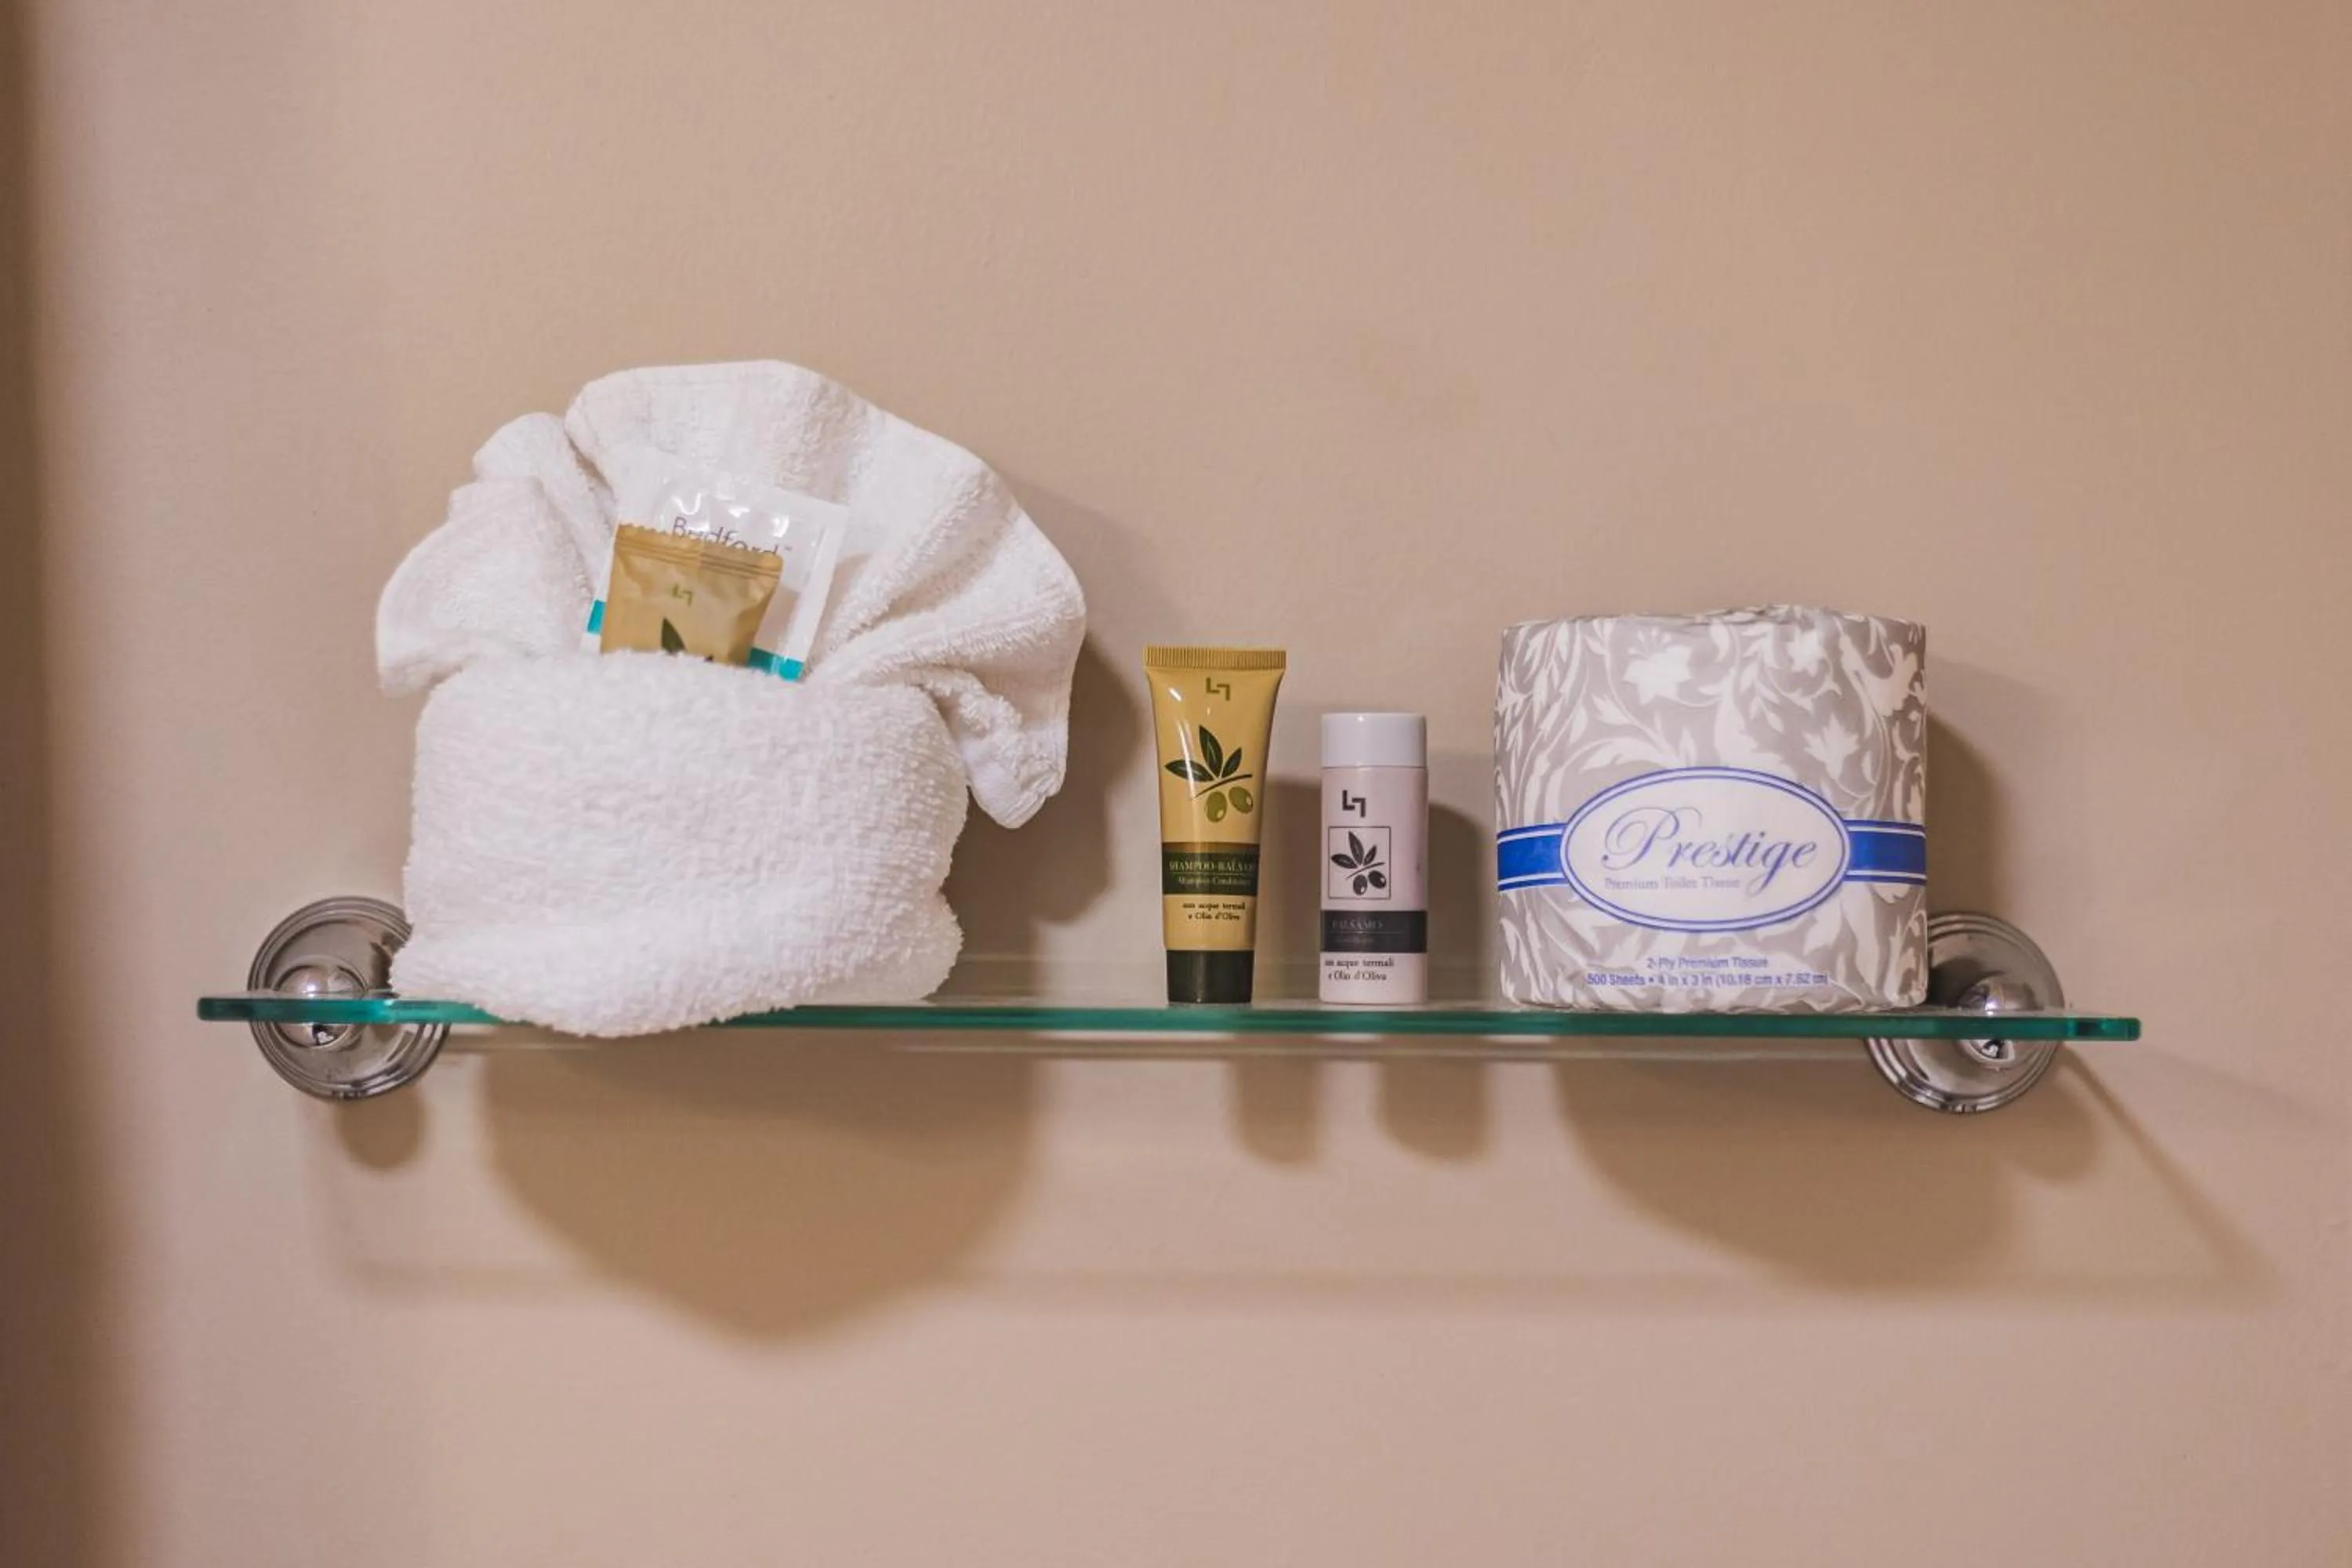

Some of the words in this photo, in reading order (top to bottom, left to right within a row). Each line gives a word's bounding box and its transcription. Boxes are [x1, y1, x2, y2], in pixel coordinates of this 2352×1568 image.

[672, 516, 779, 555] Bdfo
[1602, 807, 1817, 897] Prestige
[1605, 877, 1659, 890] Premium
[1664, 877, 1697, 890] Toilet
[1362, 956, 1394, 967] termali
[1647, 956, 1675, 970] 2-Ply
[1679, 957, 1729, 968] Premium
[1731, 956, 1769, 968] Tissue
[1334, 970, 1351, 979] Olio
[1587, 973, 1607, 985] 500
[1610, 973, 1646, 985] Sheets
[1657, 973, 1665, 985] 4
[1668, 973, 1679, 985] in
[1690, 974, 1700, 985] 3
[1702, 972, 1713, 985] in
[1755, 975, 1773, 985] cm
